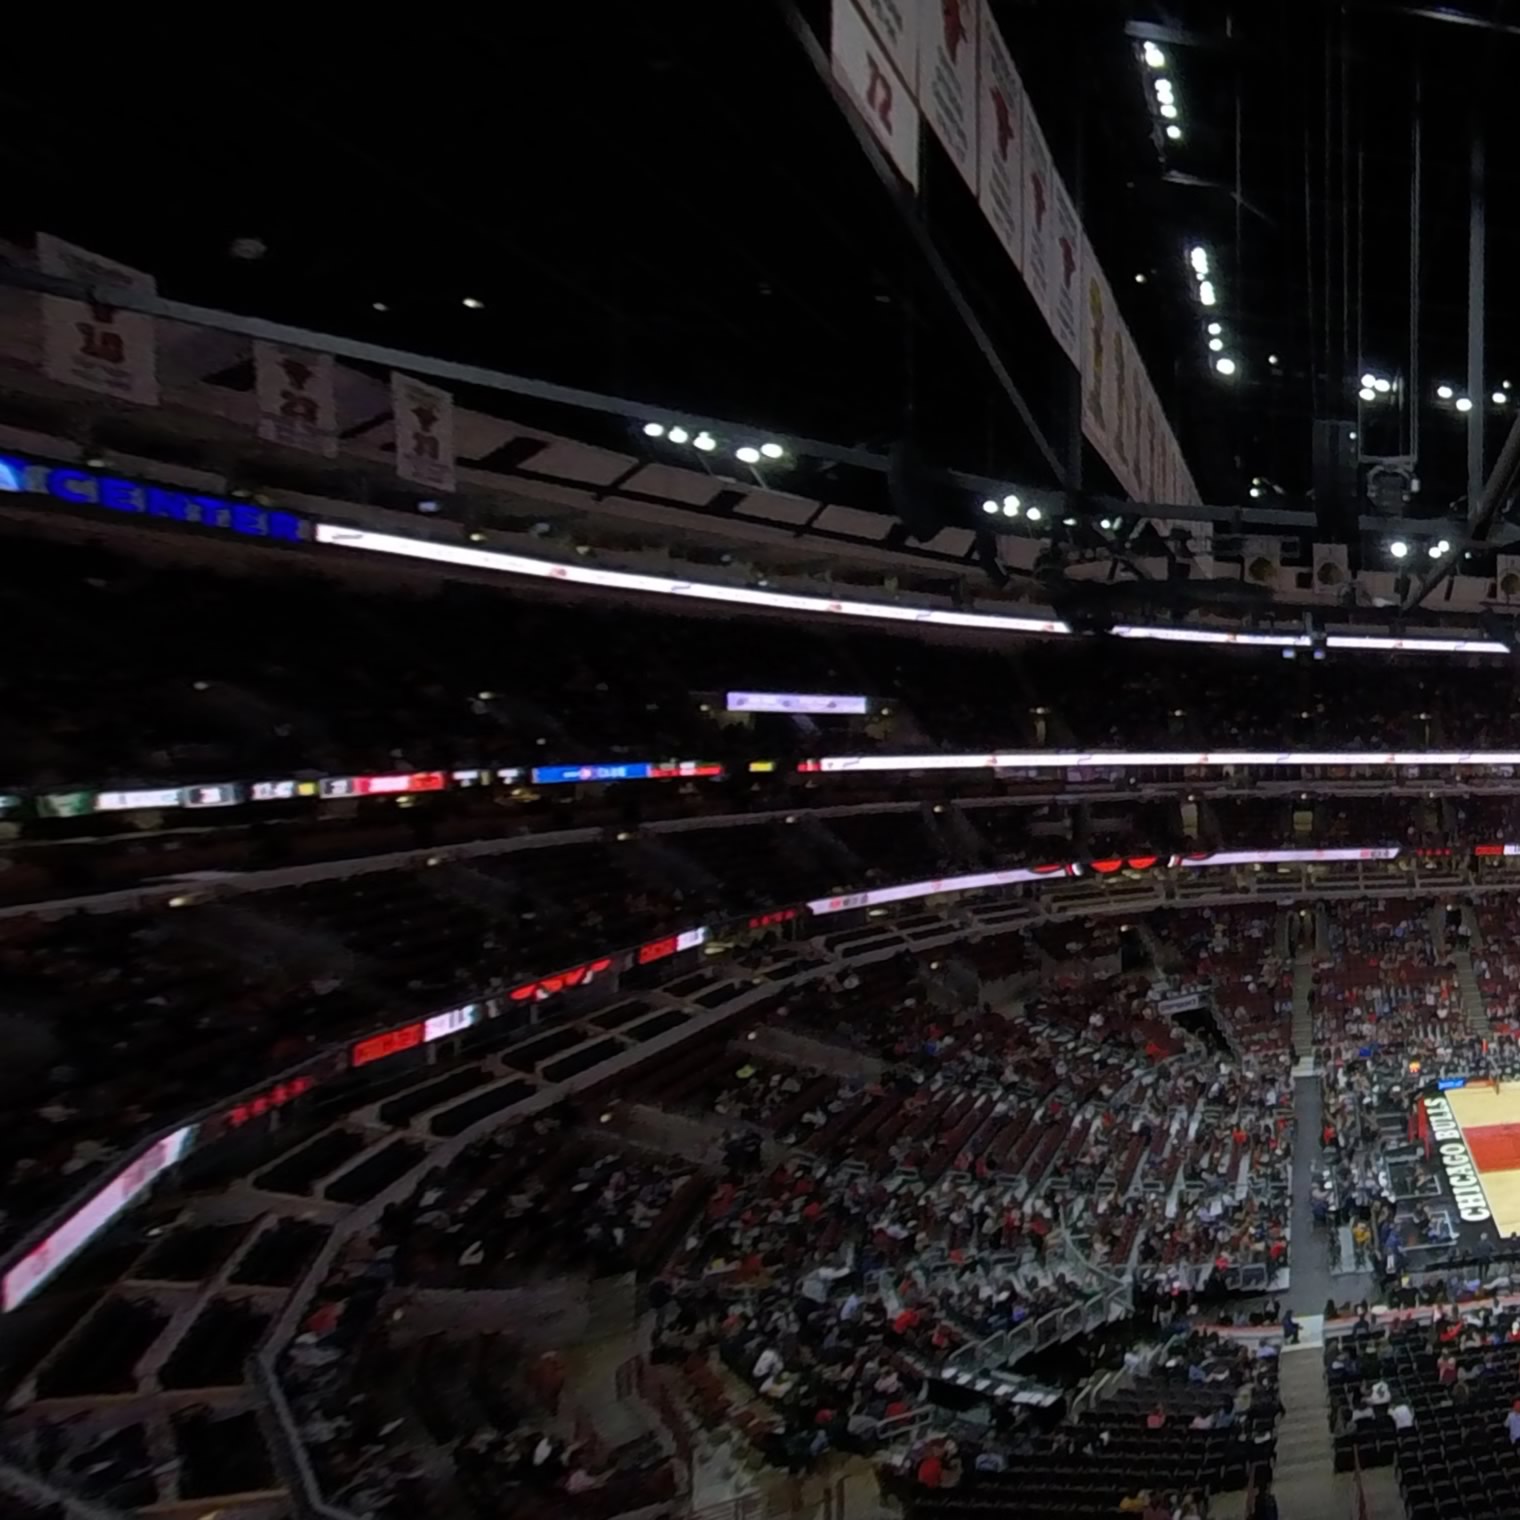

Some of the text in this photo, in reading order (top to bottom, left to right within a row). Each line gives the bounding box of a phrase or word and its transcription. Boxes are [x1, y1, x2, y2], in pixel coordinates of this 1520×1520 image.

[49, 467, 303, 542] CENTER
[1424, 1097, 1491, 1222] CHICAGO BULLS
